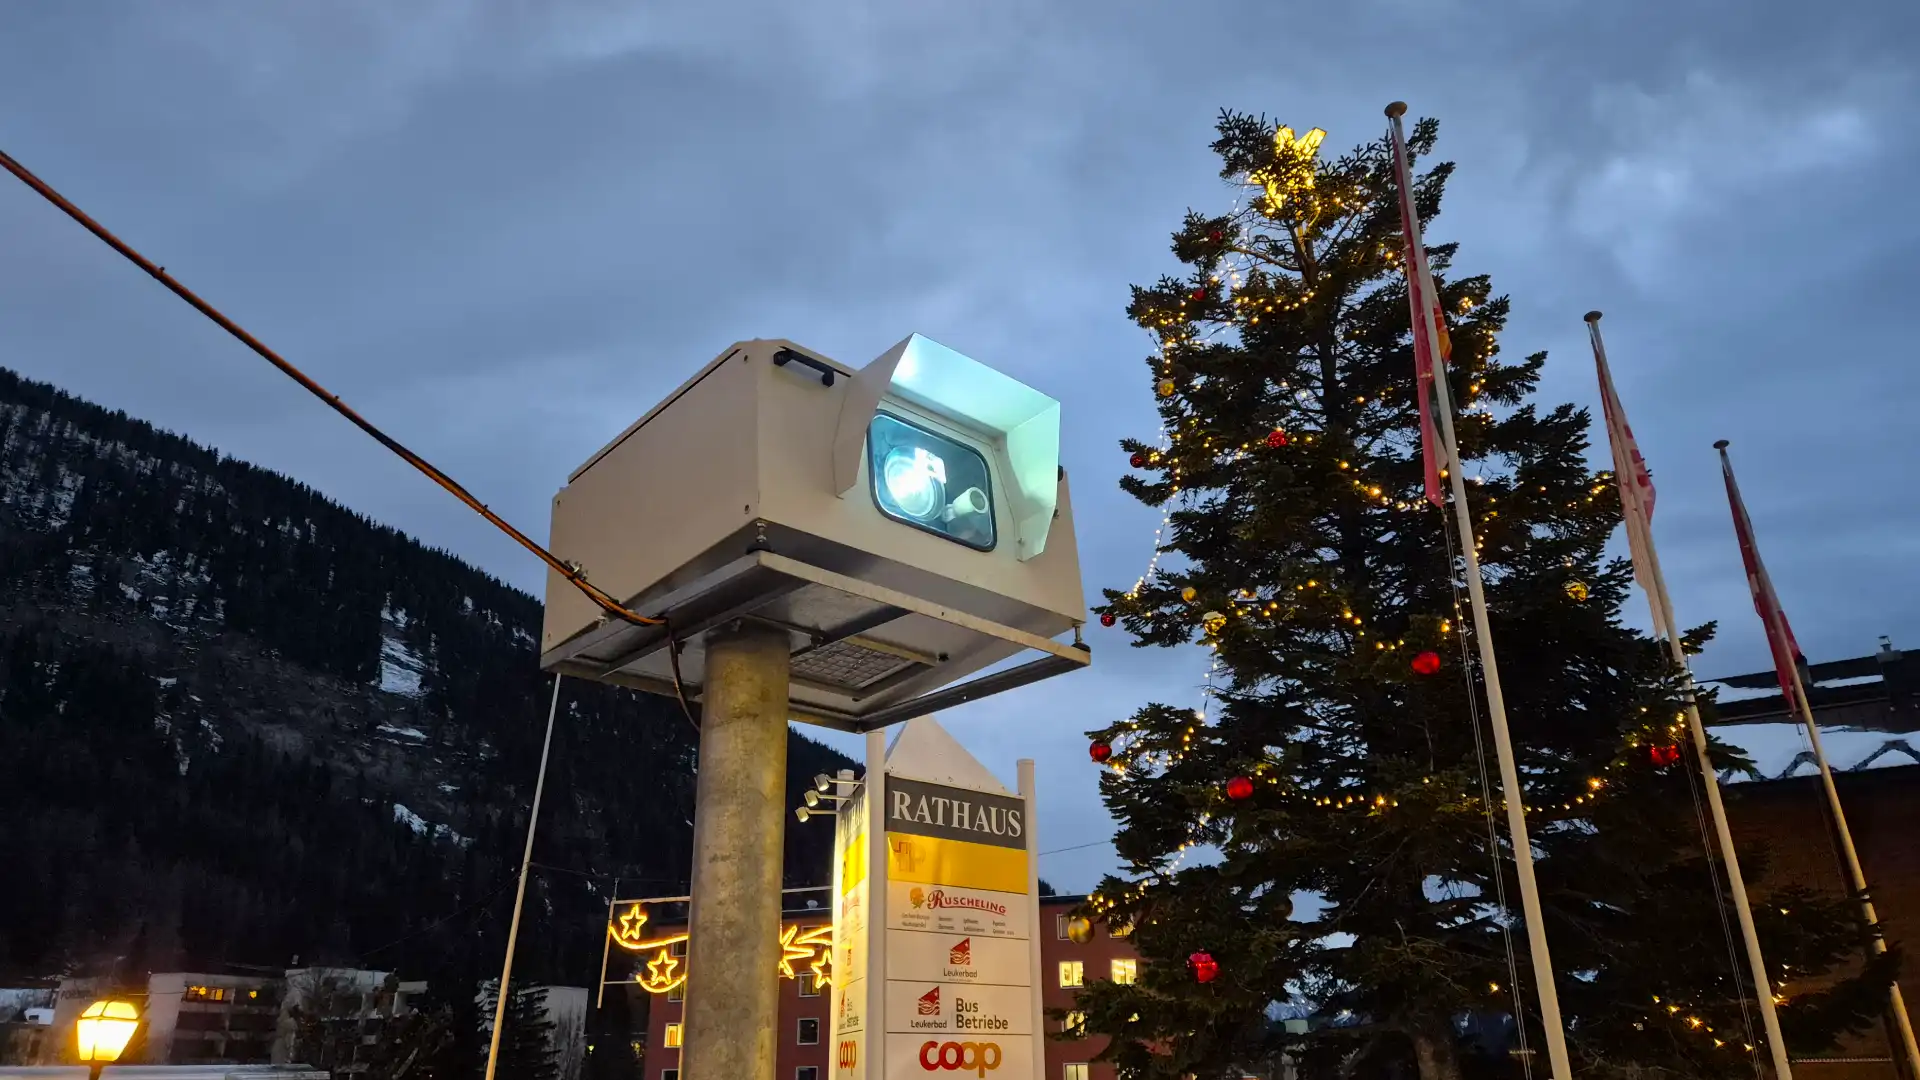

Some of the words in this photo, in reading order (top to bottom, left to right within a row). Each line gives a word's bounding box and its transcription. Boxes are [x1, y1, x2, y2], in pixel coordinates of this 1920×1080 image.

[892, 791, 1021, 837] RATHAUS
[927, 890, 1006, 914] RUSCHELING
[943, 968, 977, 978] Leukerbad
[956, 998, 978, 1012] Bus
[911, 1020, 947, 1028] Leukerbad
[956, 1014, 1008, 1029] Betriebe
[919, 1041, 1002, 1078] coop
